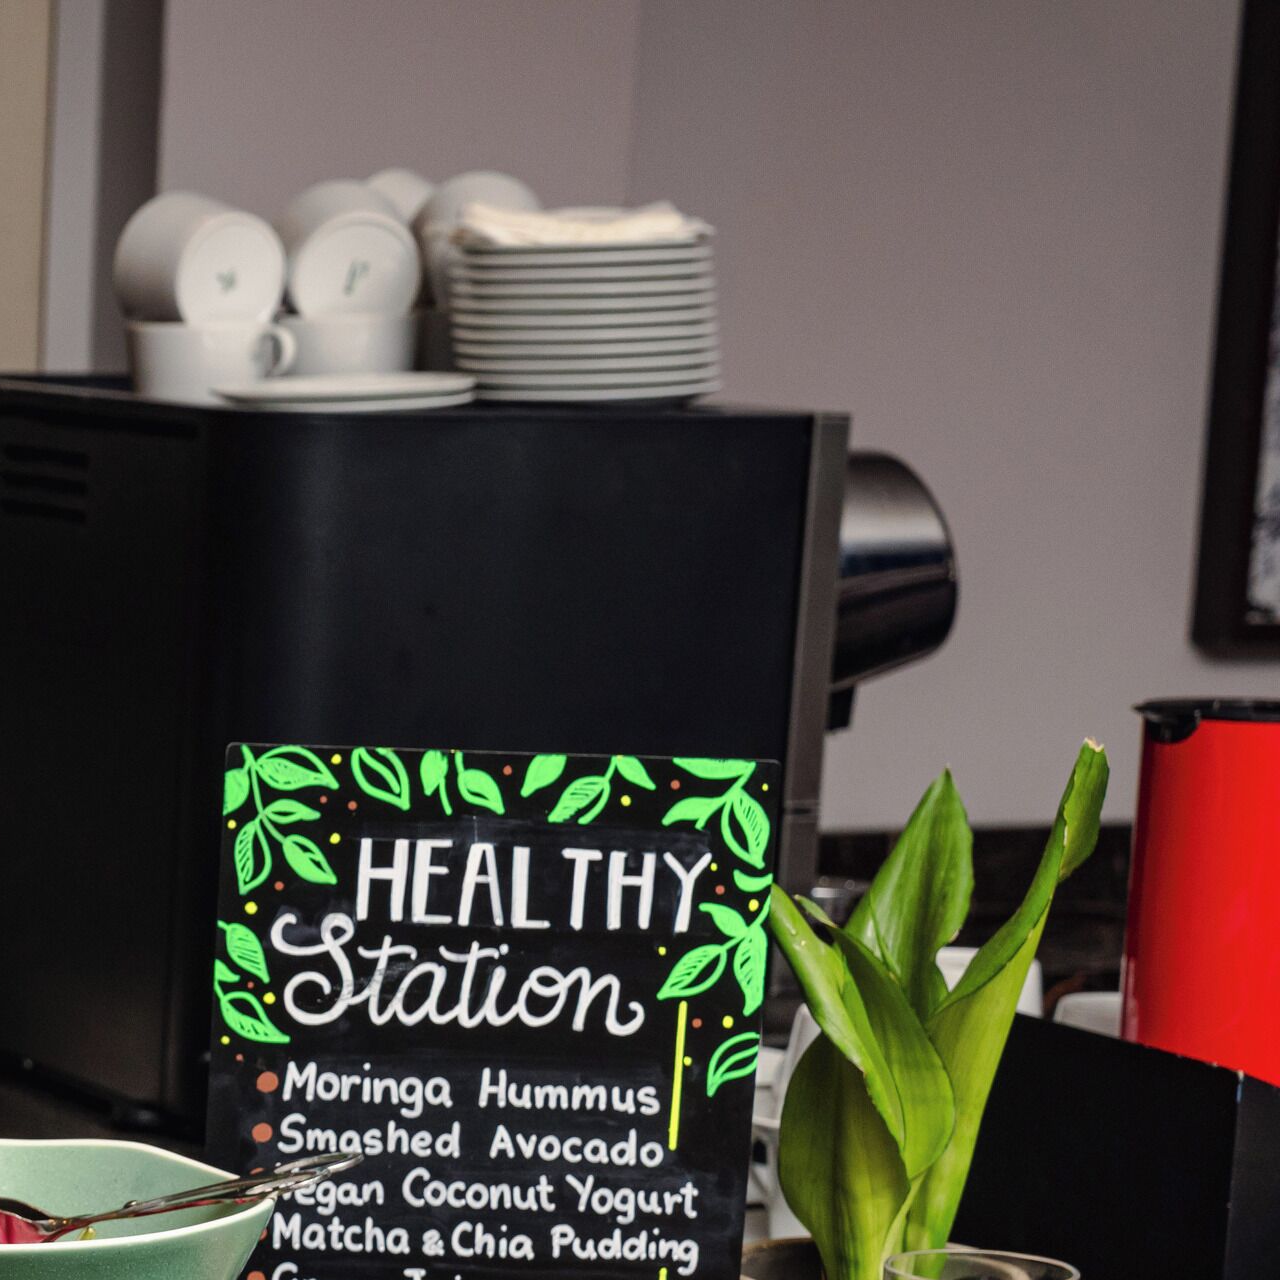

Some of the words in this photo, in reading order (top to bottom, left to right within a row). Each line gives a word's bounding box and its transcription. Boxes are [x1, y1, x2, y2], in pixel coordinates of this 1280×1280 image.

[356, 837, 712, 935] HEALTHY
[271, 911, 646, 1036] Station
[282, 1061, 453, 1118] Moringa
[479, 1068, 660, 1115] Hummus
[277, 1113, 460, 1158] Smashed
[490, 1125, 664, 1167] Avocado
[276, 1169, 384, 1216] egan
[402, 1167, 555, 1211] Coconut
[565, 1174, 698, 1224] Yogurt
[271, 1212, 410, 1255] Matcha
[422, 1229, 444, 1256] &
[452, 1226, 534, 1260] Chia
[552, 1227, 699, 1275] Pudding
